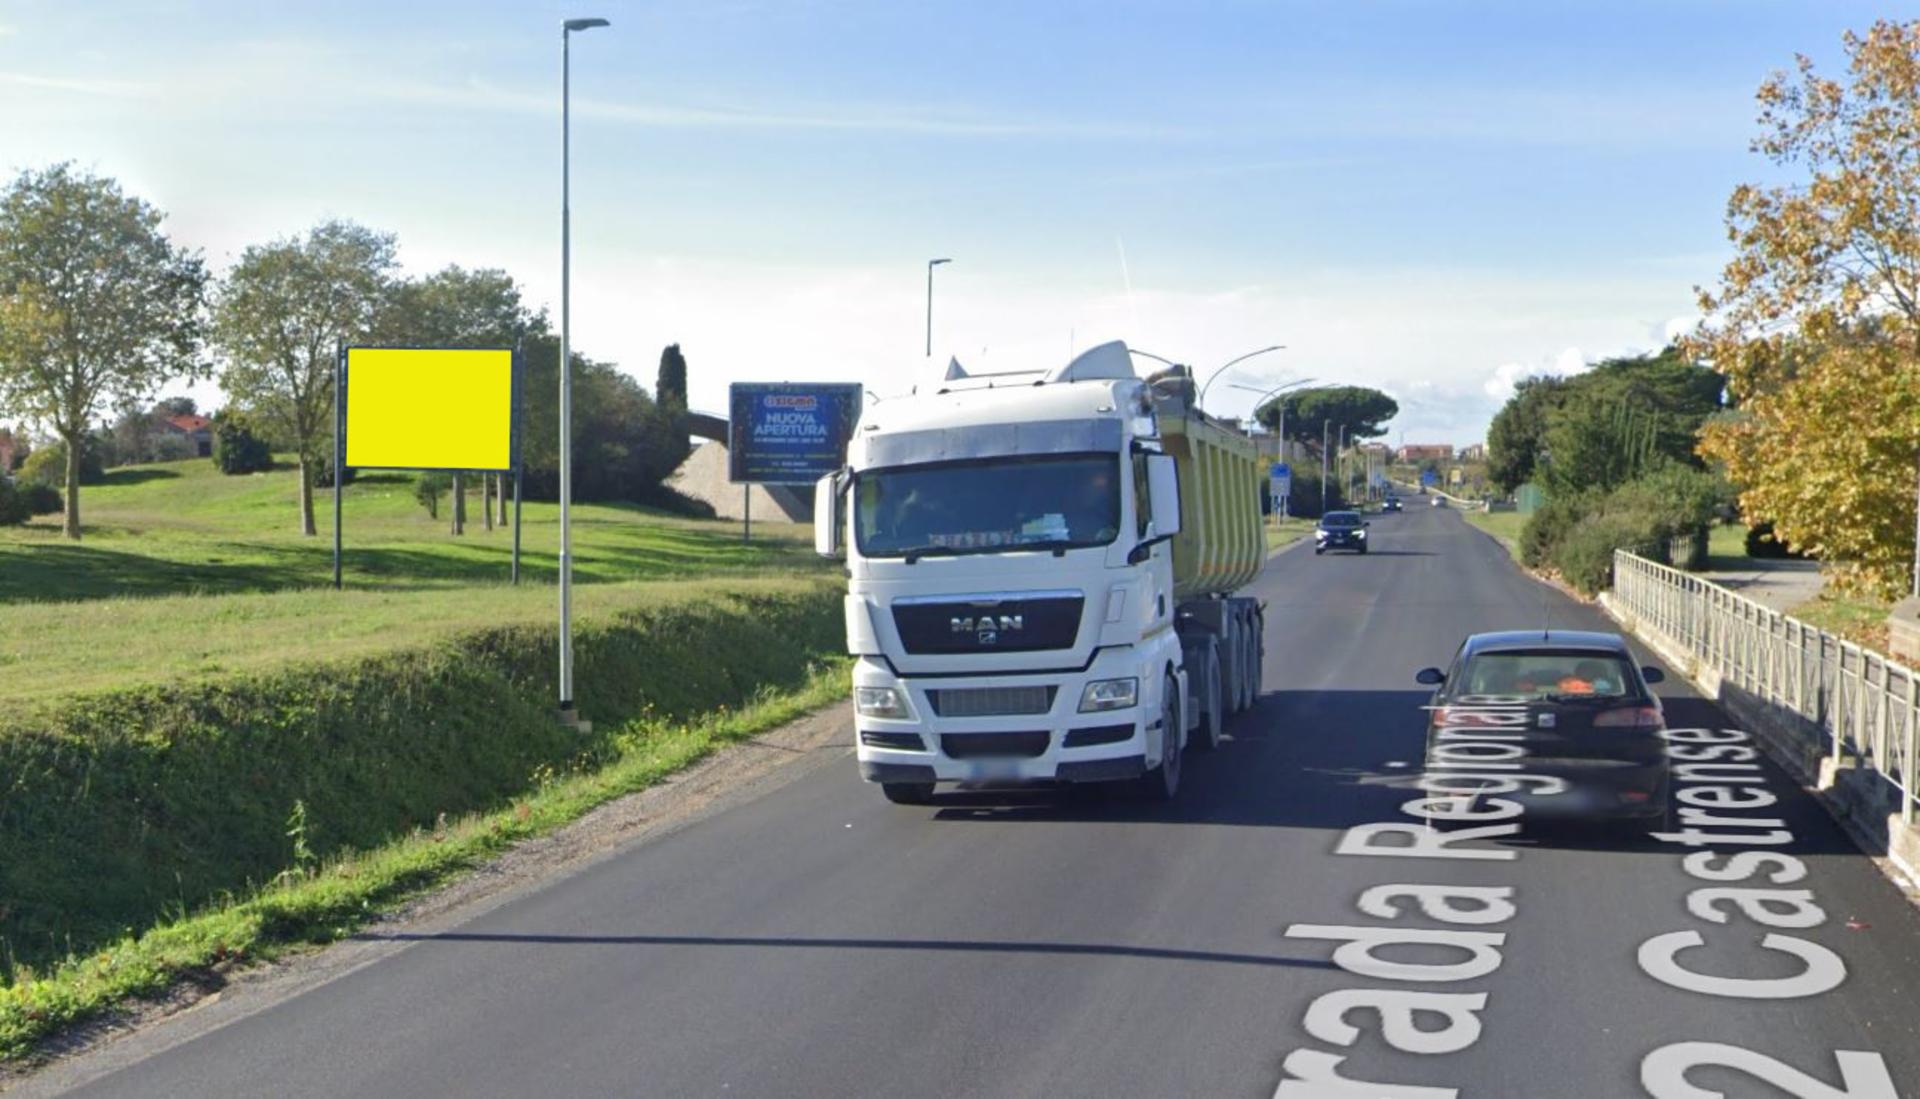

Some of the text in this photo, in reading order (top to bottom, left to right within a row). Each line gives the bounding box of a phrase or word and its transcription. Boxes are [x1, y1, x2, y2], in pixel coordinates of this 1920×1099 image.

[766, 413, 816, 425] NUOVA
[754, 424, 828, 436] APERTURA
[951, 615, 1023, 632] MAN
